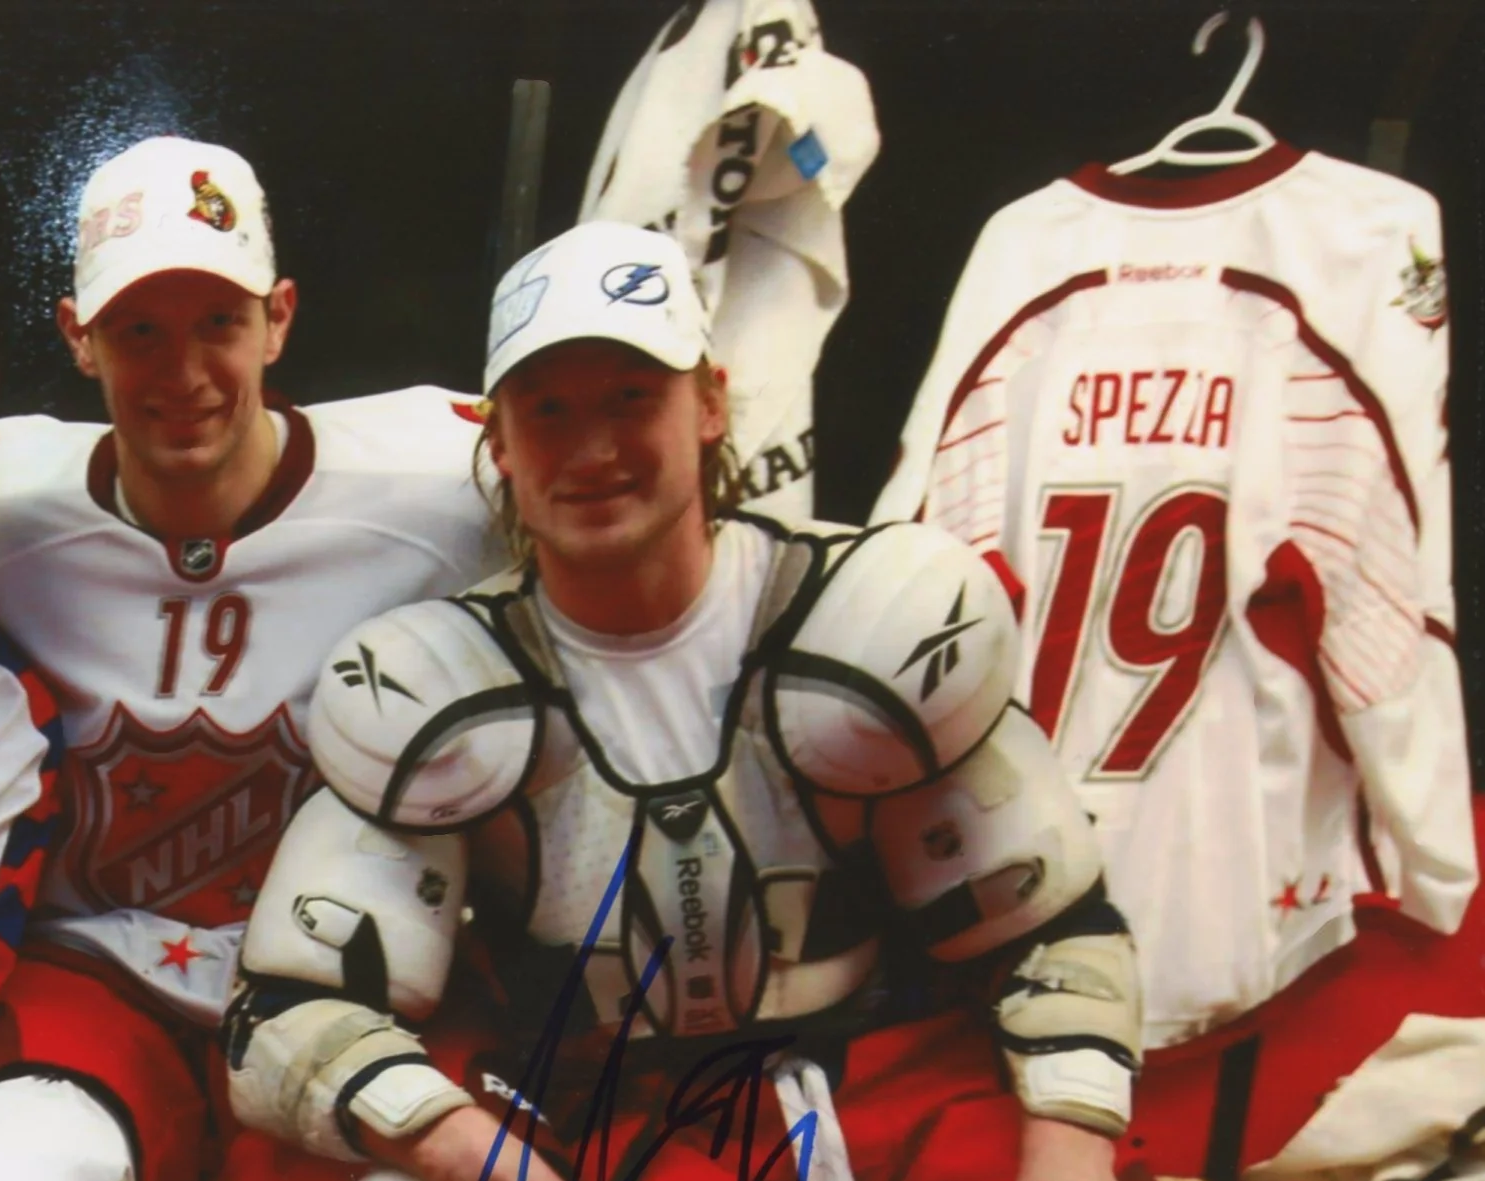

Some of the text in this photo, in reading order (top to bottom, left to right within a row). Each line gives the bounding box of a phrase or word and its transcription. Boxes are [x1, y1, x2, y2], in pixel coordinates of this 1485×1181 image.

[155, 590, 254, 699] 19
[1030, 479, 1230, 784] 19
[127, 786, 273, 904] NHL
[675, 857, 713, 962] Reebok
